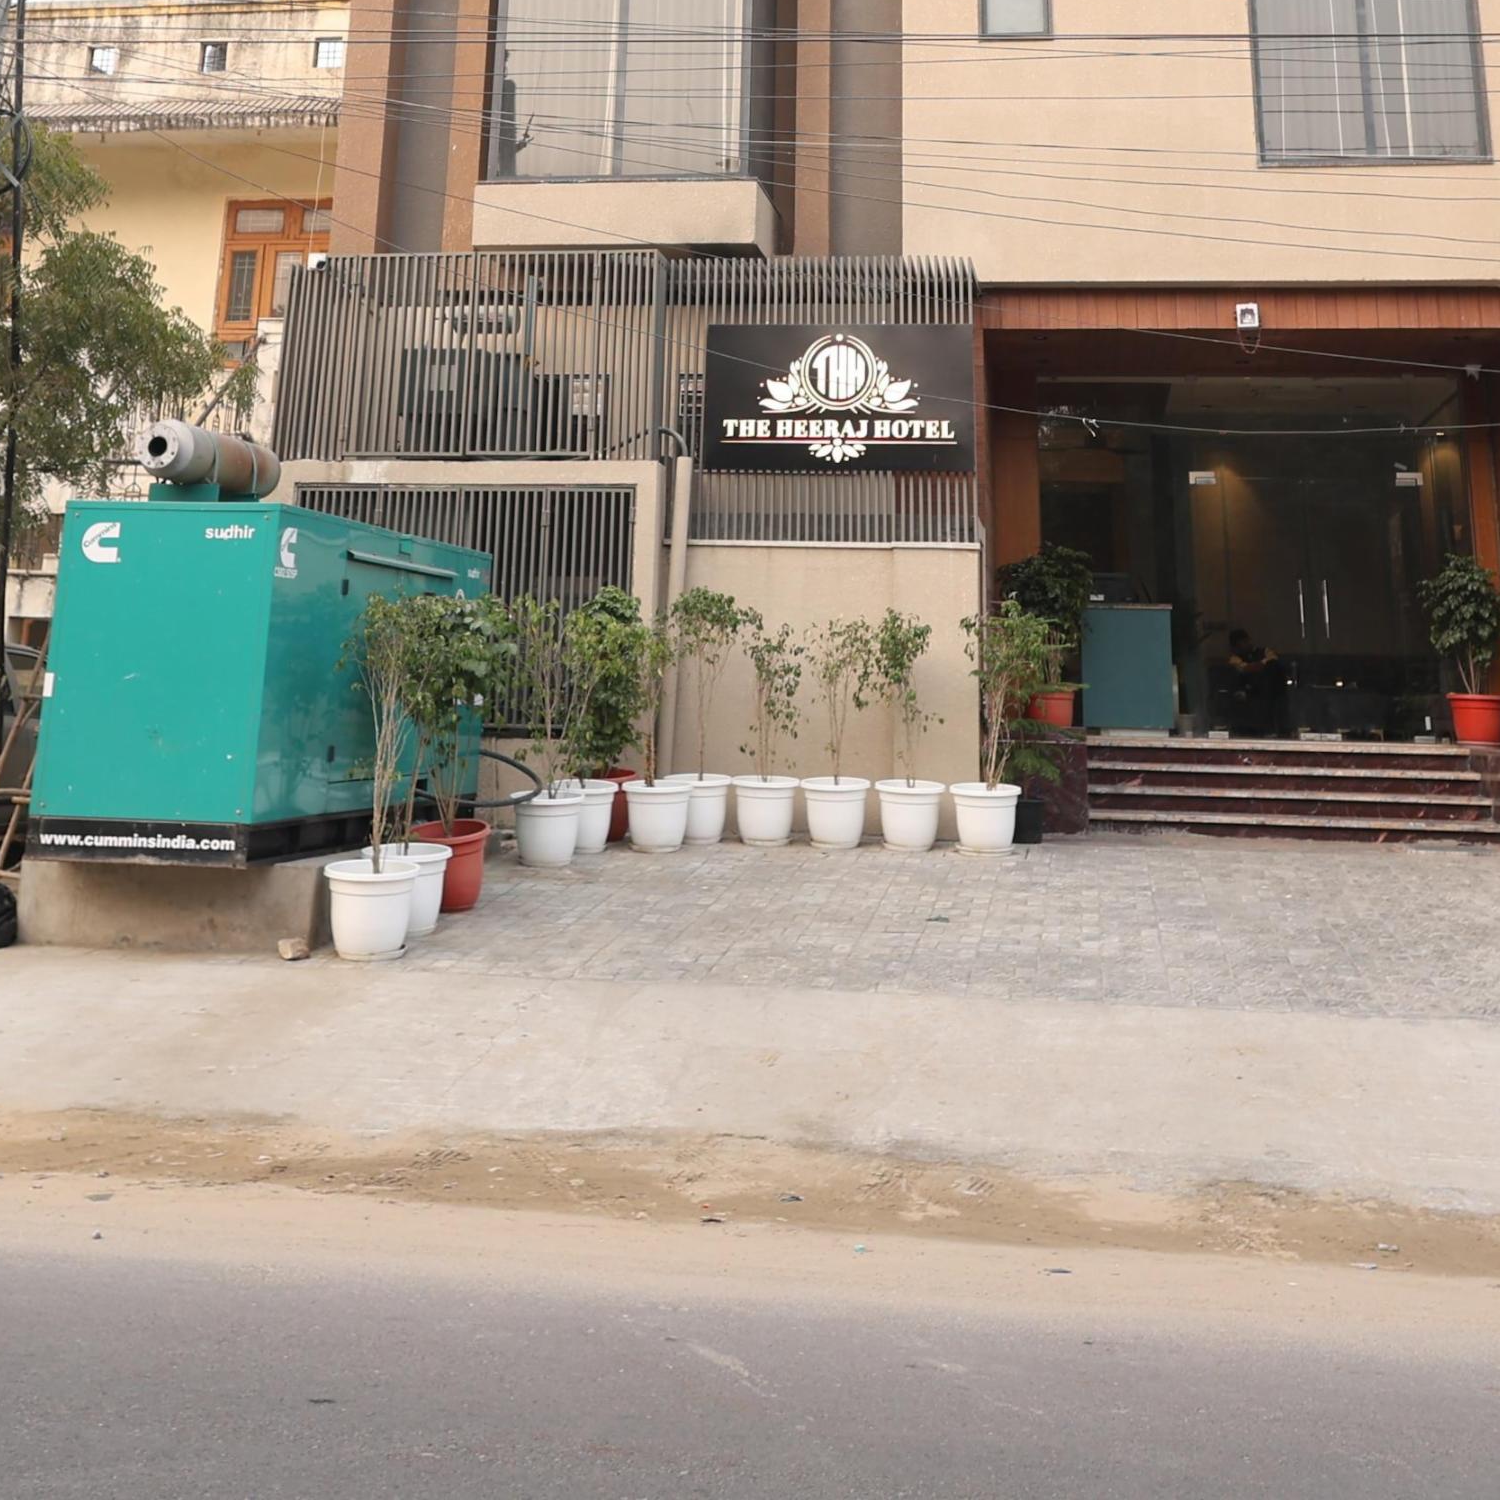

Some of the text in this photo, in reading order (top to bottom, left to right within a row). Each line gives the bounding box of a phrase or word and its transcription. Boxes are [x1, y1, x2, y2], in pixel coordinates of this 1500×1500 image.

[723, 419, 955, 439] THE HEERAJ HOTEL
[205, 525, 256, 540] sudhir
[40, 833, 236, 850] www.cumminsindia.com
